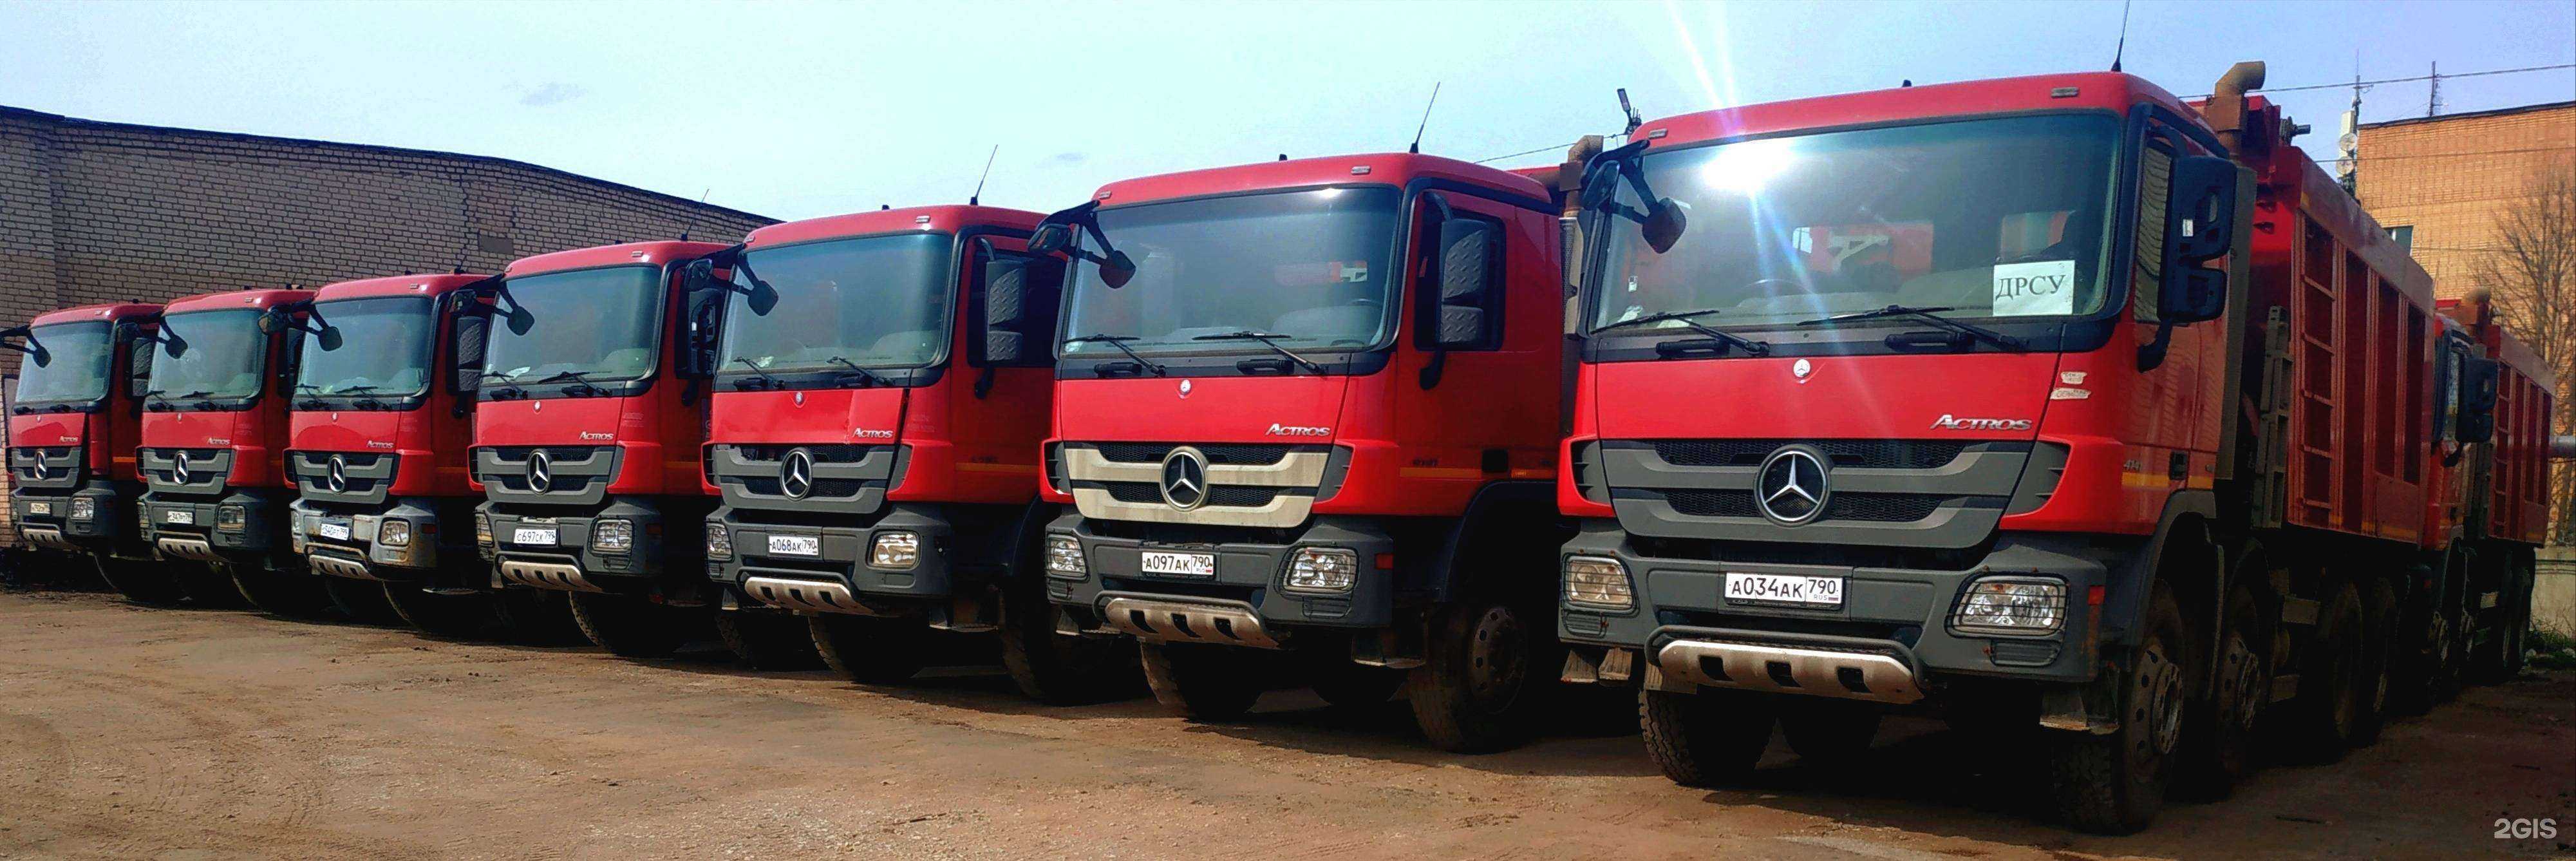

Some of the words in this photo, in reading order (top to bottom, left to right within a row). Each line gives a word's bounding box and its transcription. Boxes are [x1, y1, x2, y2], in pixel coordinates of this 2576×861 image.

[1996, 275, 2066, 301] ДРСУ
[1192, 556, 1210, 567] 790
[1809, 580, 1836, 594] 790
